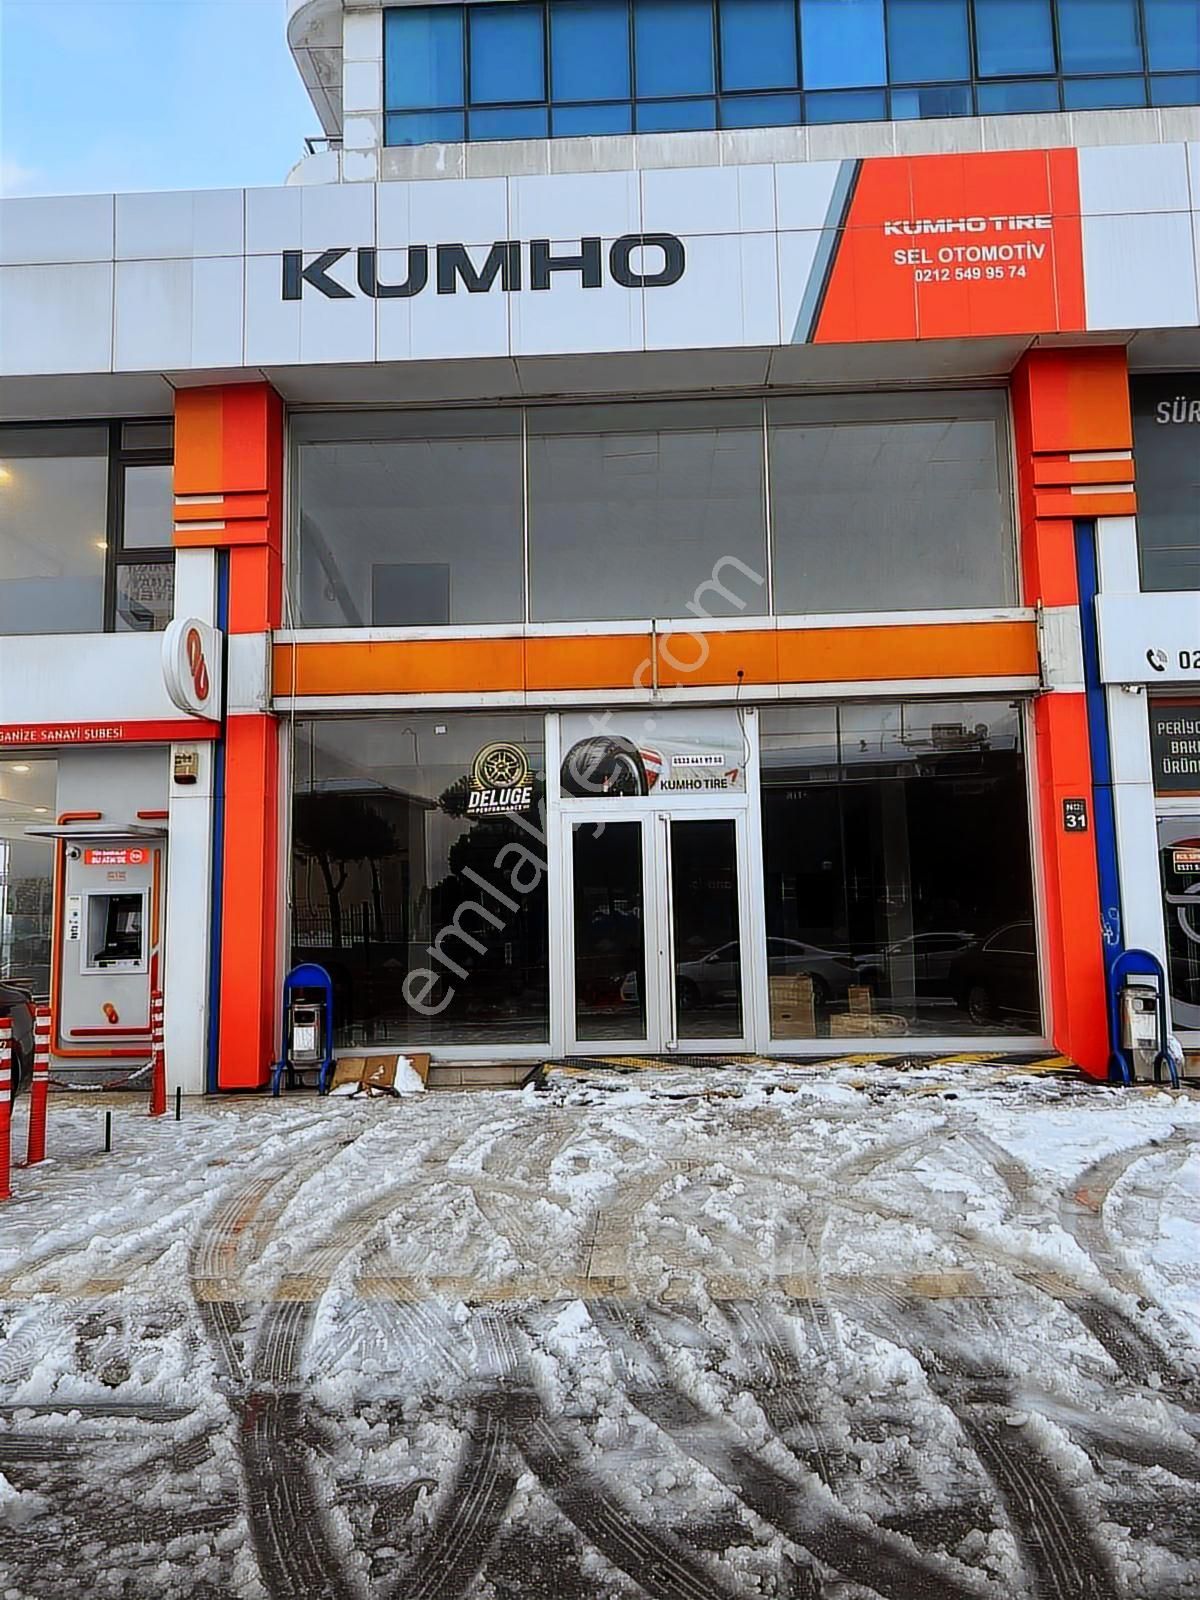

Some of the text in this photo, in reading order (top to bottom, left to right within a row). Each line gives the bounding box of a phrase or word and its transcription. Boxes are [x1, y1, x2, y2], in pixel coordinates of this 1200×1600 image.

[884, 214, 1053, 235] KUMHO TIRE
[894, 240, 1045, 265] SEL OTOMOTİV
[282, 233, 685, 300] KUMHO
[915, 265, 1027, 282] 0212 549 95 74
[1156, 396, 1200, 424] SÜR
[41, 726, 80, 741] SANAYİ
[660, 778, 728, 790] KUMHO TIRE
[468, 787, 533, 809] DELUGE
[1066, 814, 1086, 828] 31
